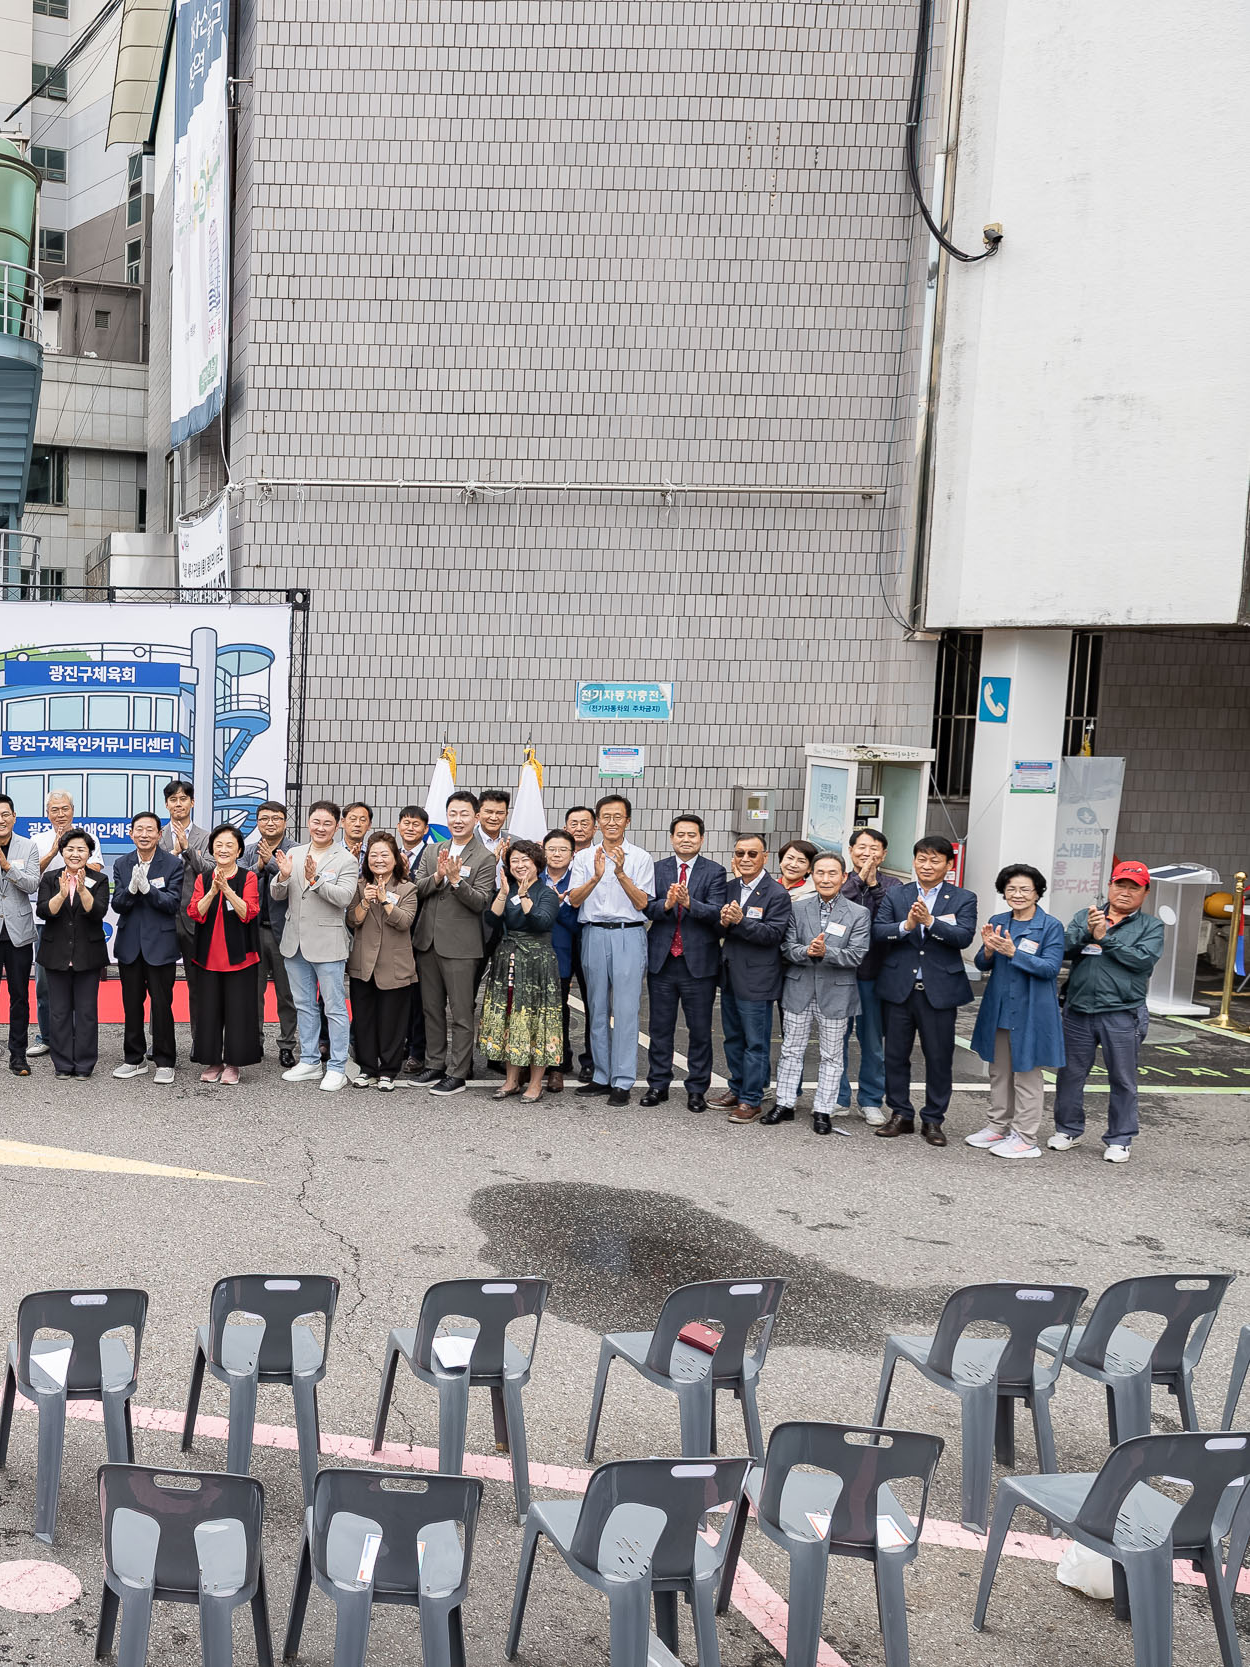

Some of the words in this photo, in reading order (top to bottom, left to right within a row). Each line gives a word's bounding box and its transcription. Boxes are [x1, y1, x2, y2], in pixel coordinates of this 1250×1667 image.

[48, 665, 136, 683] 광진구체육회
[632, 704, 661, 713] 주차금지)
[8, 735, 174, 753] 광진구체육인커뮤니티센터
